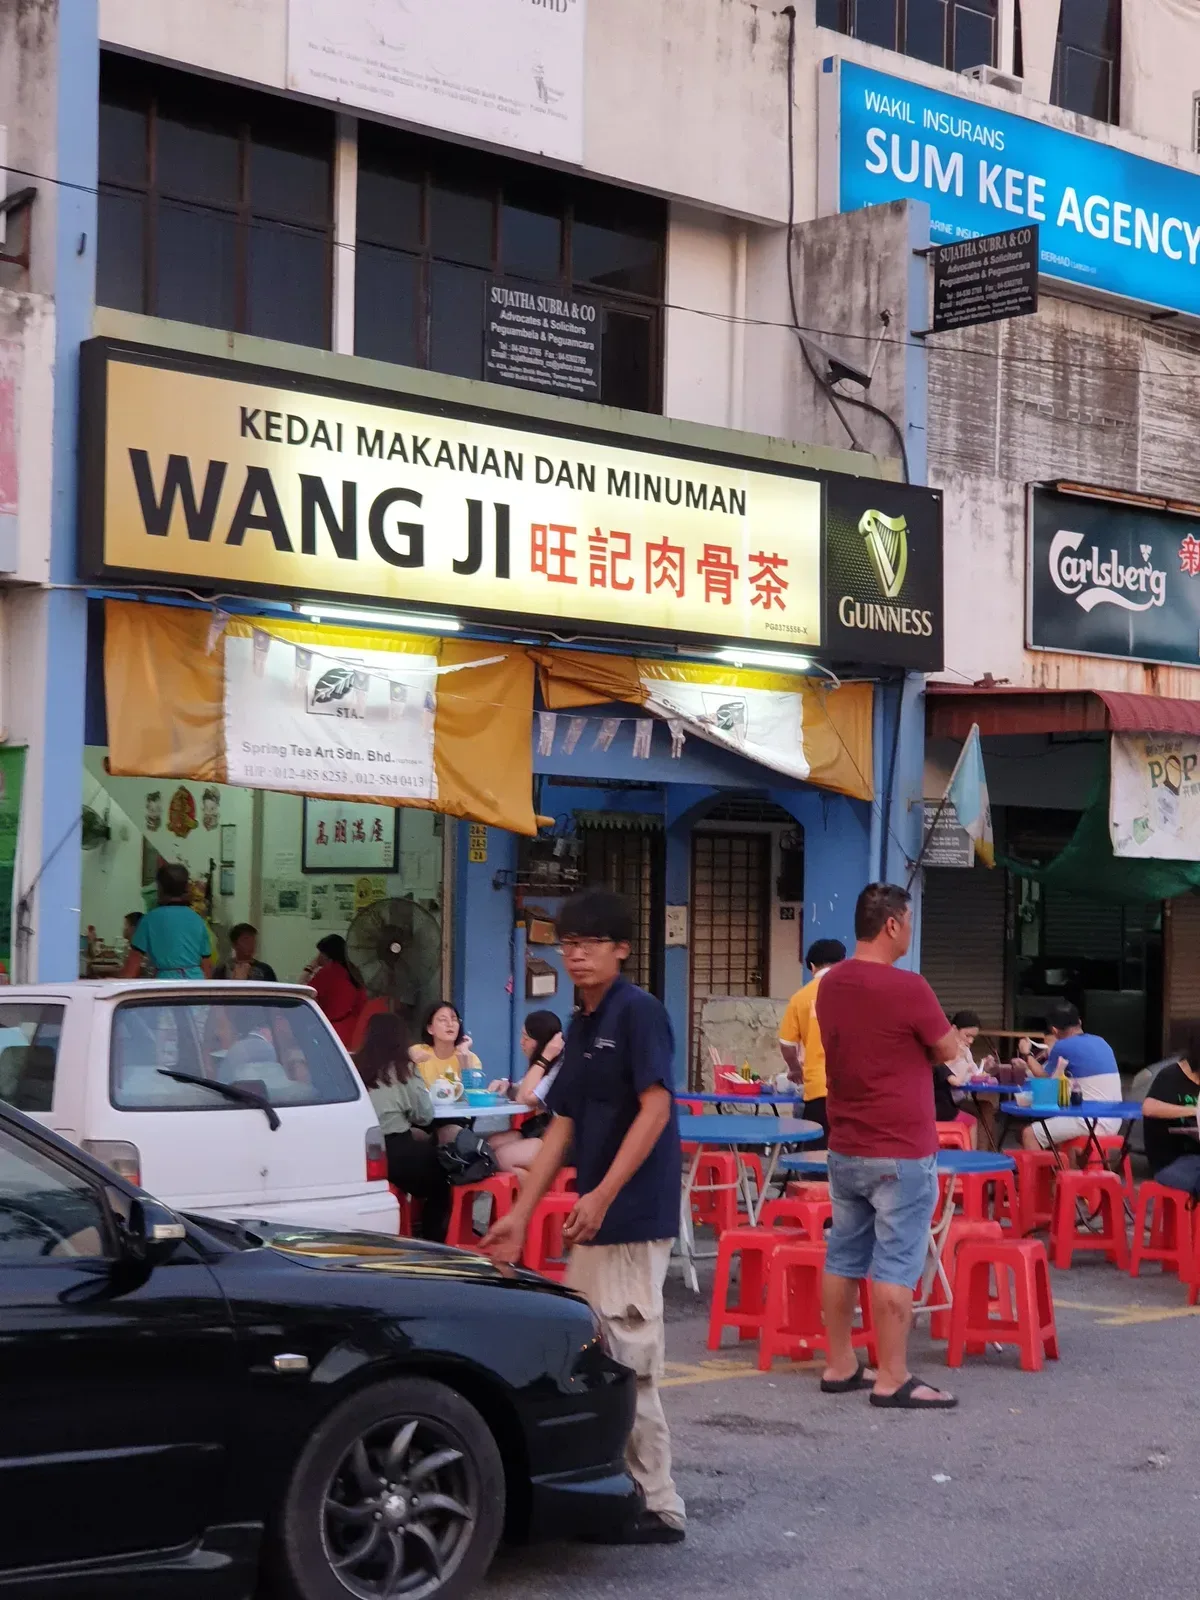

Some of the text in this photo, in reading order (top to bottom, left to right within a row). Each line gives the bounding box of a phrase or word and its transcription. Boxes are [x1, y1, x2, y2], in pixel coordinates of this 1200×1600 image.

[864, 89, 1005, 151] WAKIL INSURANS
[865, 127, 1200, 265] SUM KEE AGENCY
[940, 229, 1032, 263] SUJATHA SUBRA & CO
[947, 260, 982, 274] Advocates
[990, 251, 1023, 265] Solicitors
[1041, 250, 1071, 268] BERHAD
[491, 286, 596, 322] SUJATHA SUBRA & CO
[500, 310, 586, 335] Advocates & Solicitors
[491, 322, 595, 350] Peguambela & Peguamcara
[240, 405, 746, 517] KEDAI MAKANAN DAN MINUMAN
[128, 447, 511, 580] WANG JI
[530, 522, 790, 612] 旺記肉骨茶
[1049, 529, 1168, 610] Carlsberg
[838, 596, 934, 637] GUINNESS
[242, 742, 287, 758] Spring
[289, 744, 312, 757] Tea
[315, 746, 335, 759] Art
[337, 747, 365, 761] Sdn.
[367, 751, 396, 763] Bhd.
